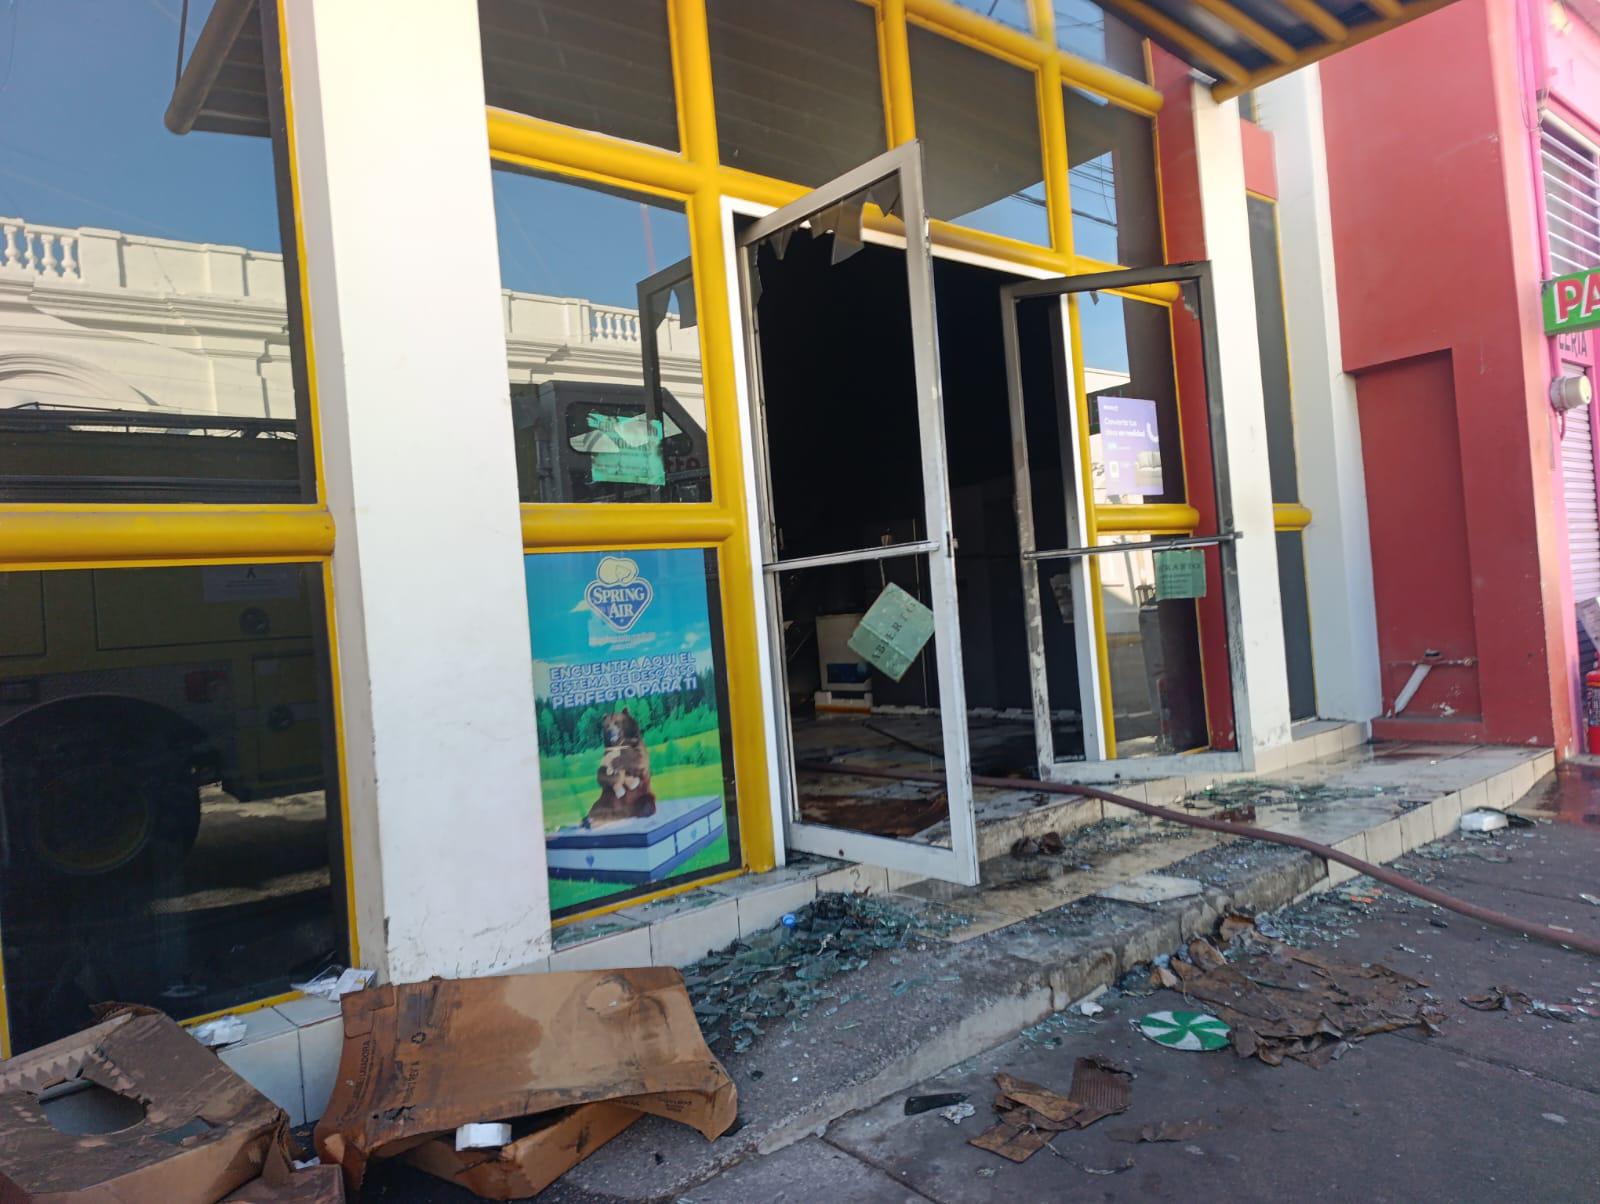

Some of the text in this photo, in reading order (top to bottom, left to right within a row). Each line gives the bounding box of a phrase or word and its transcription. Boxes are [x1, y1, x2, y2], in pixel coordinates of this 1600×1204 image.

[1553, 273, 1600, 324] PA
[592, 587, 646, 605] SPRING
[609, 603, 636, 619] AIR
[549, 651, 697, 682] ENCUENTRA AQUI EL
[550, 663, 696, 695] SISTEMA DE DESCANSO
[551, 675, 698, 710] PERFECTO PARA TI
